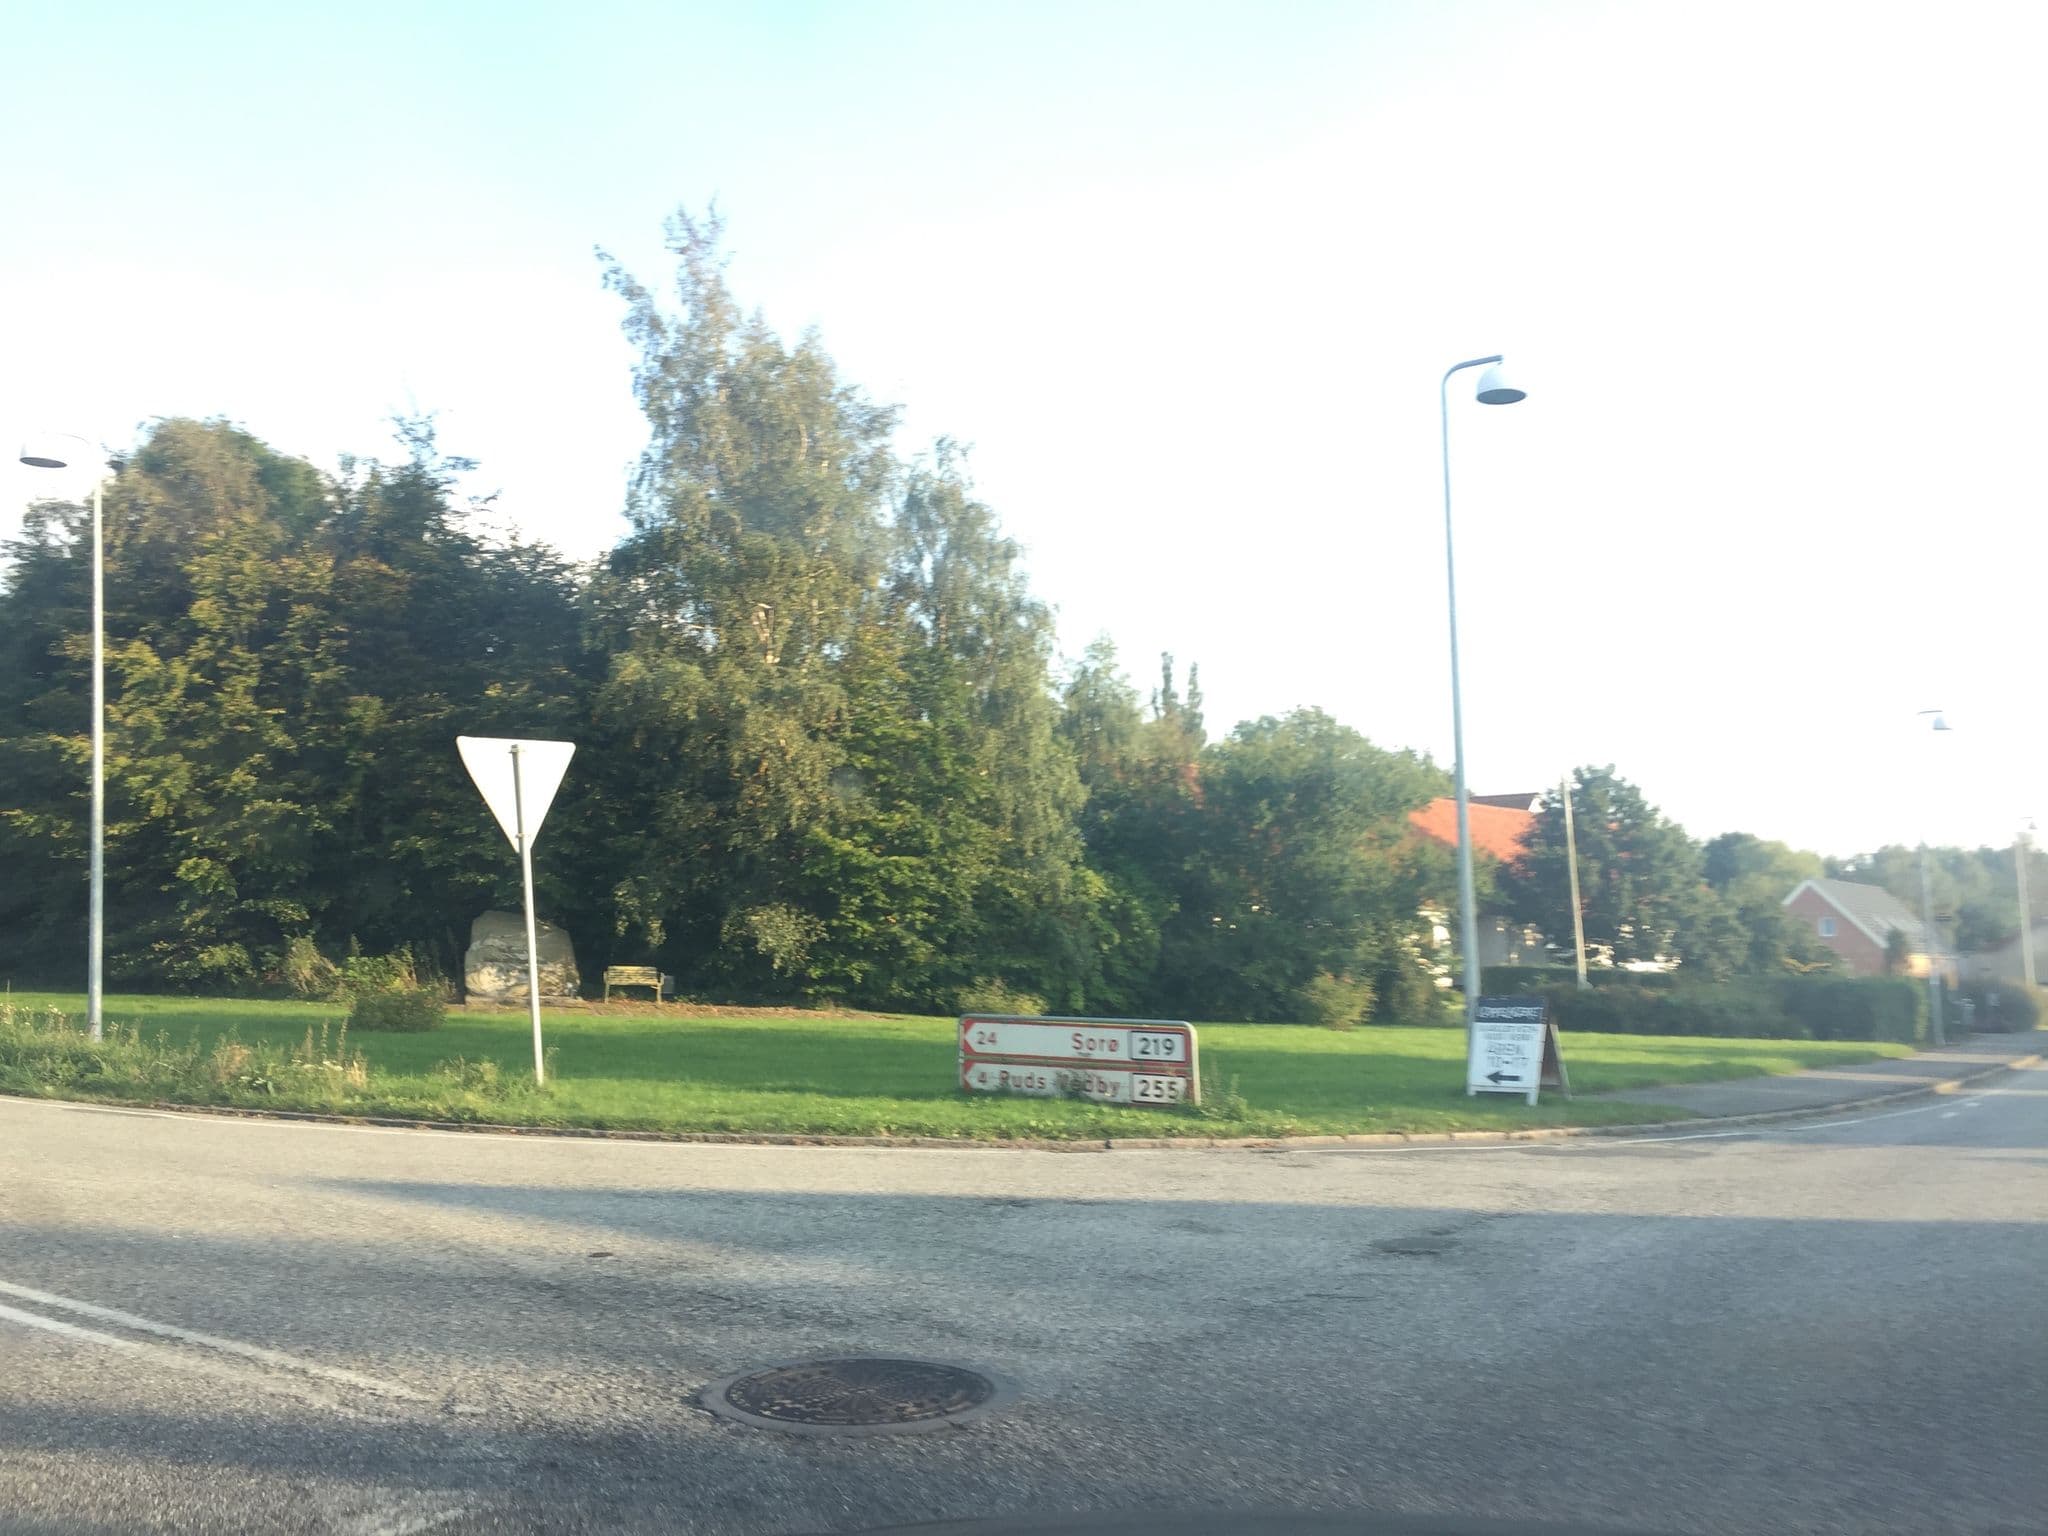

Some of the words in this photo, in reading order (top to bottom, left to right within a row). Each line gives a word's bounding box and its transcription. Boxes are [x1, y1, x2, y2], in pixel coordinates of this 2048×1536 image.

[976, 1031, 998, 1046] 24
[1071, 1033, 1119, 1052] Sorø
[1138, 1037, 1175, 1055] 219
[977, 1071, 987, 1084] 4
[1139, 1080, 1180, 1099] 255
